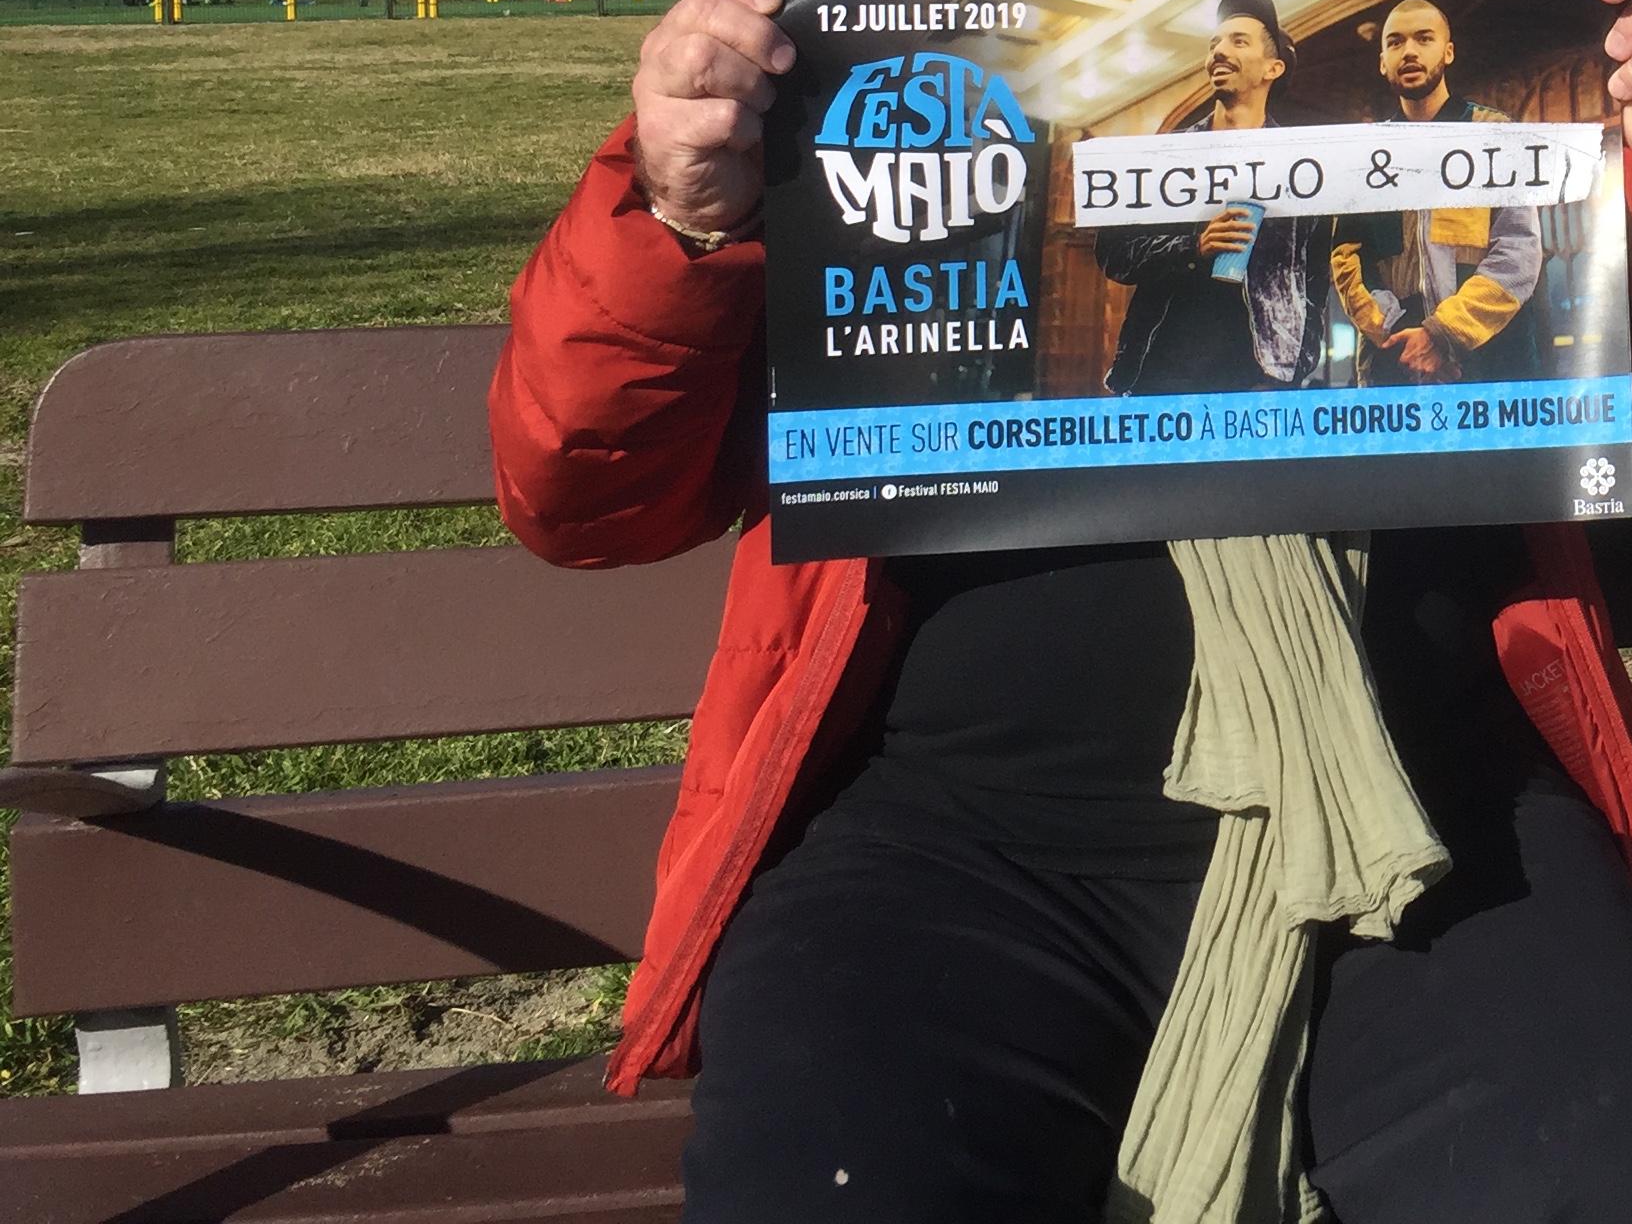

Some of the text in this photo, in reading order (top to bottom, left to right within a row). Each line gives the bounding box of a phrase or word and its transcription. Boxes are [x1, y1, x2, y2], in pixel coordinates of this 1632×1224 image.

[817, 2, 1028, 32] 12 JUILLET 2019
[814, 52, 1036, 148] FESTA
[1081, 144, 1551, 210] BIGFLO & OLI
[826, 259, 1029, 317] BASTIA
[826, 319, 1029, 357] L'ARINELLA
[786, 393, 1616, 460] EN VENTE SUR CORSEBILLET.CO À BASTIA CHORUS & 2B MUSIQUE
[781, 480, 999, 505] festamaio.corsica Festival FESTA MAIO
[1519, 658, 1565, 696] JACKET
